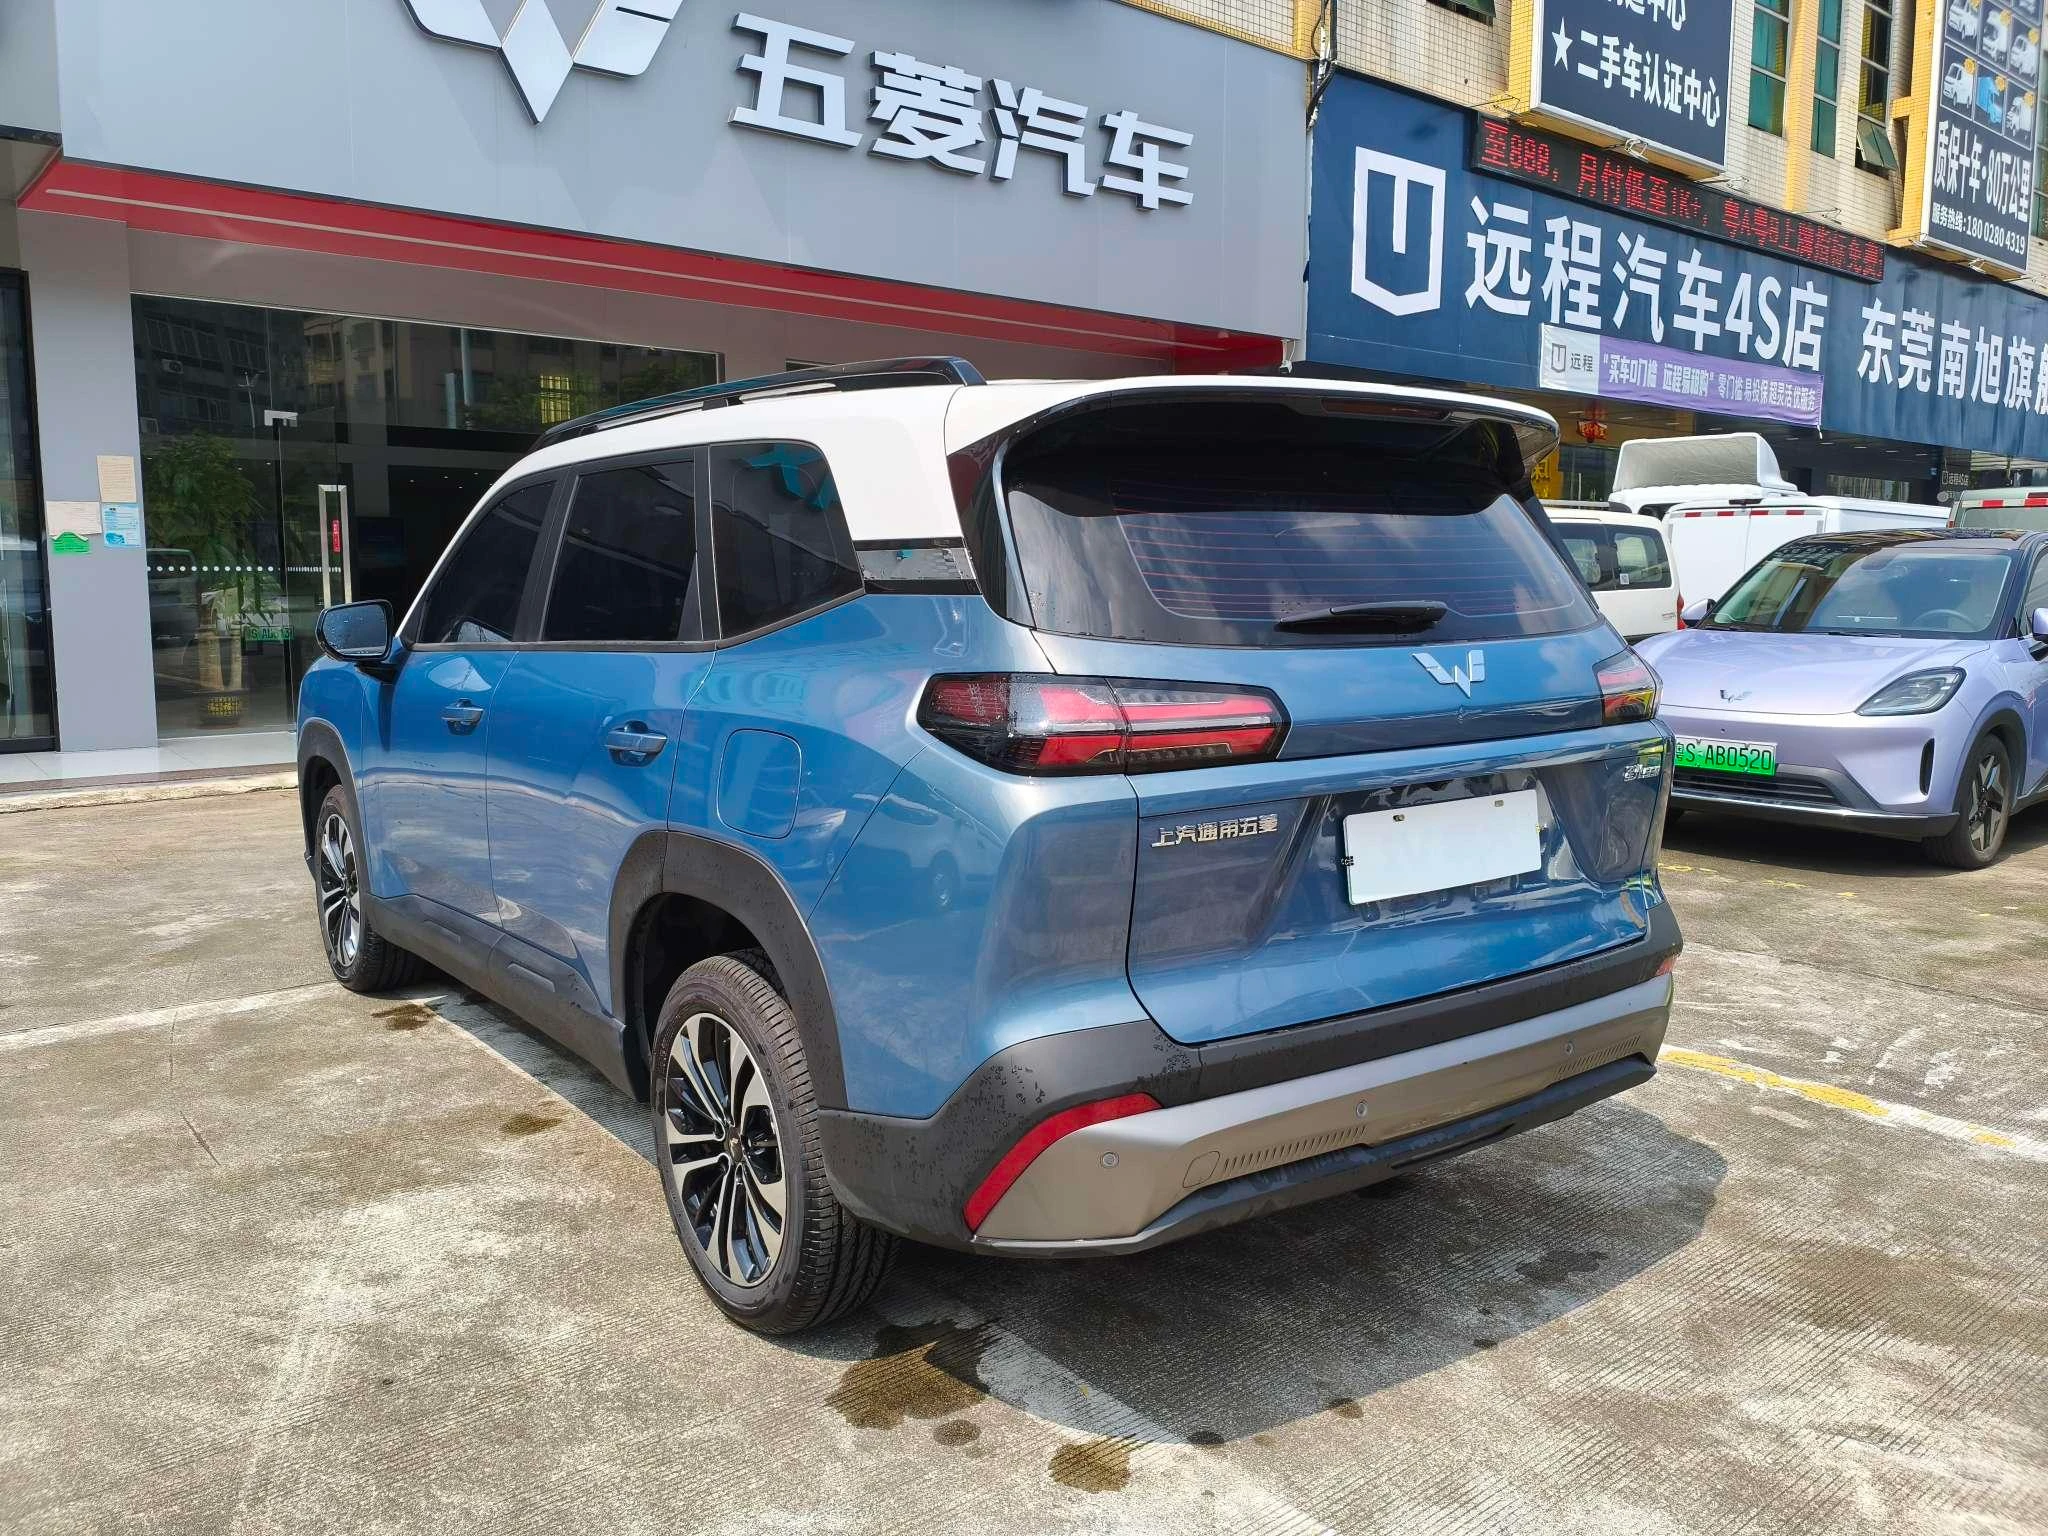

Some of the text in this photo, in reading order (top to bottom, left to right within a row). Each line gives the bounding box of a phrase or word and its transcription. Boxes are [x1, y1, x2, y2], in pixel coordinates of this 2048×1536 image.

[729, 12, 1194, 210] 五菱汽车
[1577, 30, 1720, 127] 二手车认证中心
[1934, 120, 2031, 222] 质保十年·80万公里
[1465, 195, 1828, 371] 远程汽车4S店
[1983, 224, 2005, 247] 0280
[2005, 234, 2025, 255] 4319
[1570, 352, 1593, 373] 远程
[1151, 813, 1278, 848] 上汽通用五菱
